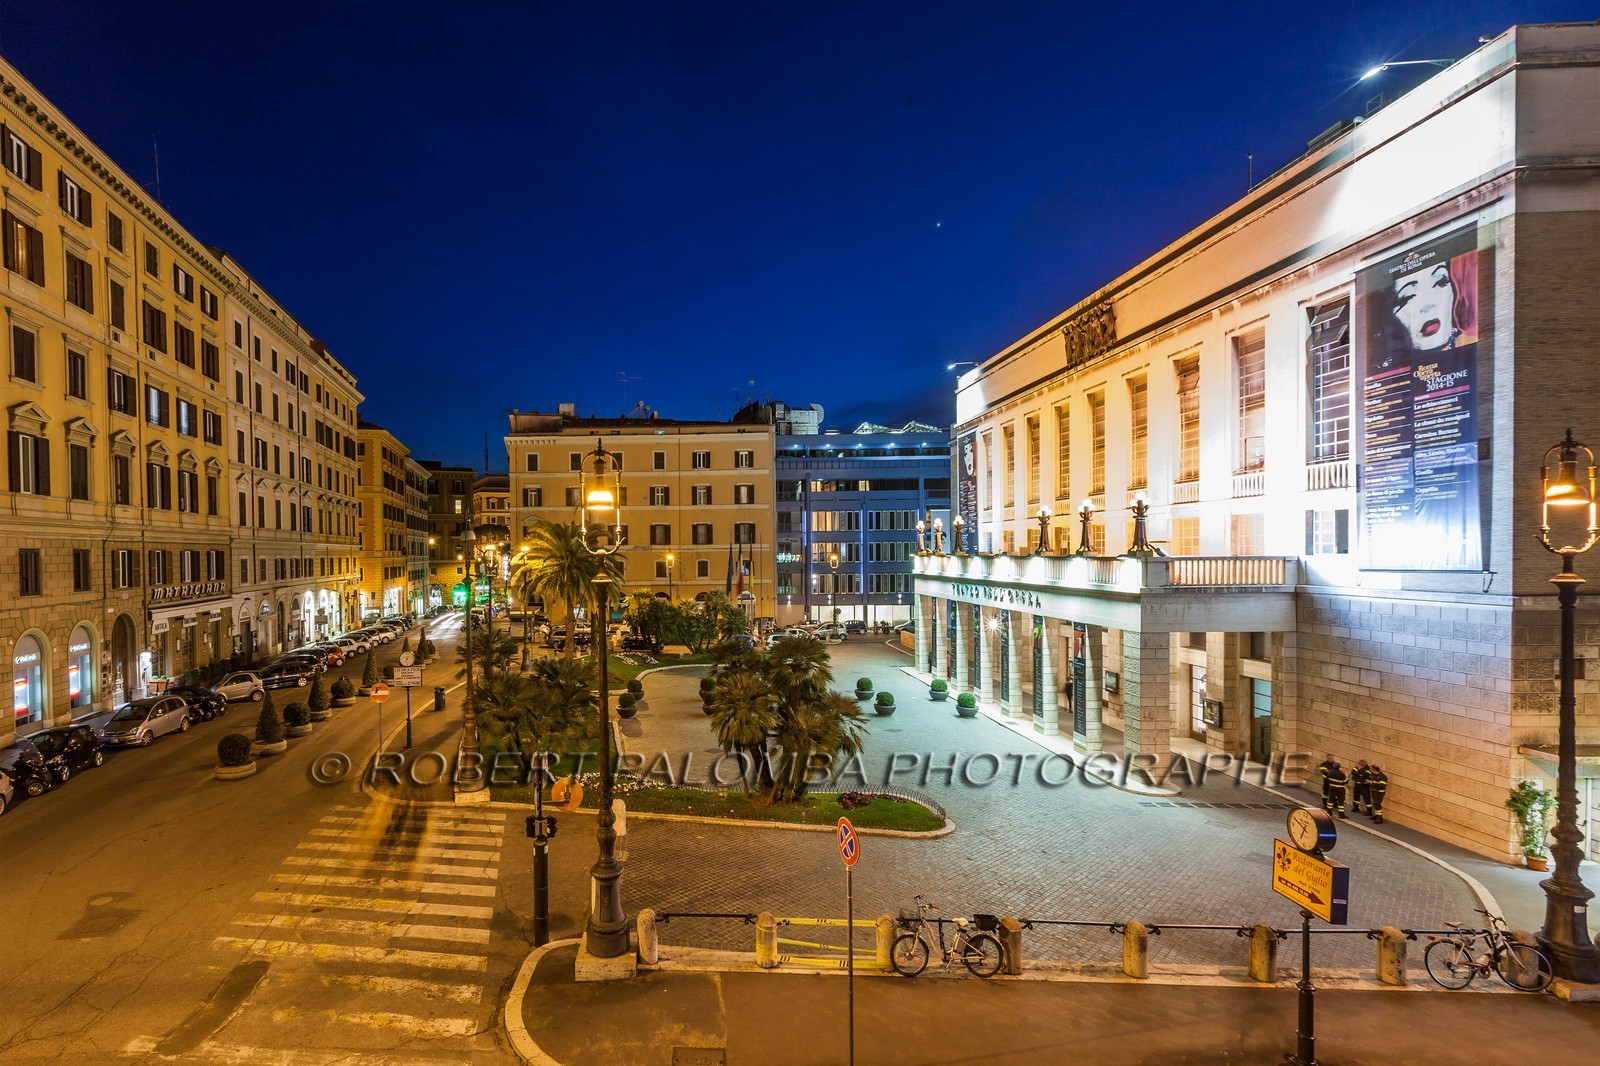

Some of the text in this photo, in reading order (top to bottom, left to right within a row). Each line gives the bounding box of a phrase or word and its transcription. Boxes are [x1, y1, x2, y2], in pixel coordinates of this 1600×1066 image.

[1389, 263, 1406, 274] TEATRO
[1408, 262, 1422, 270] ROMA
[1418, 363, 1438, 372] Roma
[1426, 370, 1468, 385] STAGIONE
[1426, 380, 1454, 392] 2014-15
[154, 582, 226, 600] MATRICIANA
[952, 583, 980, 599] TEATRO
[1293, 852, 1330, 878] Ristorante
[1294, 864, 1328, 888] del Giglio
